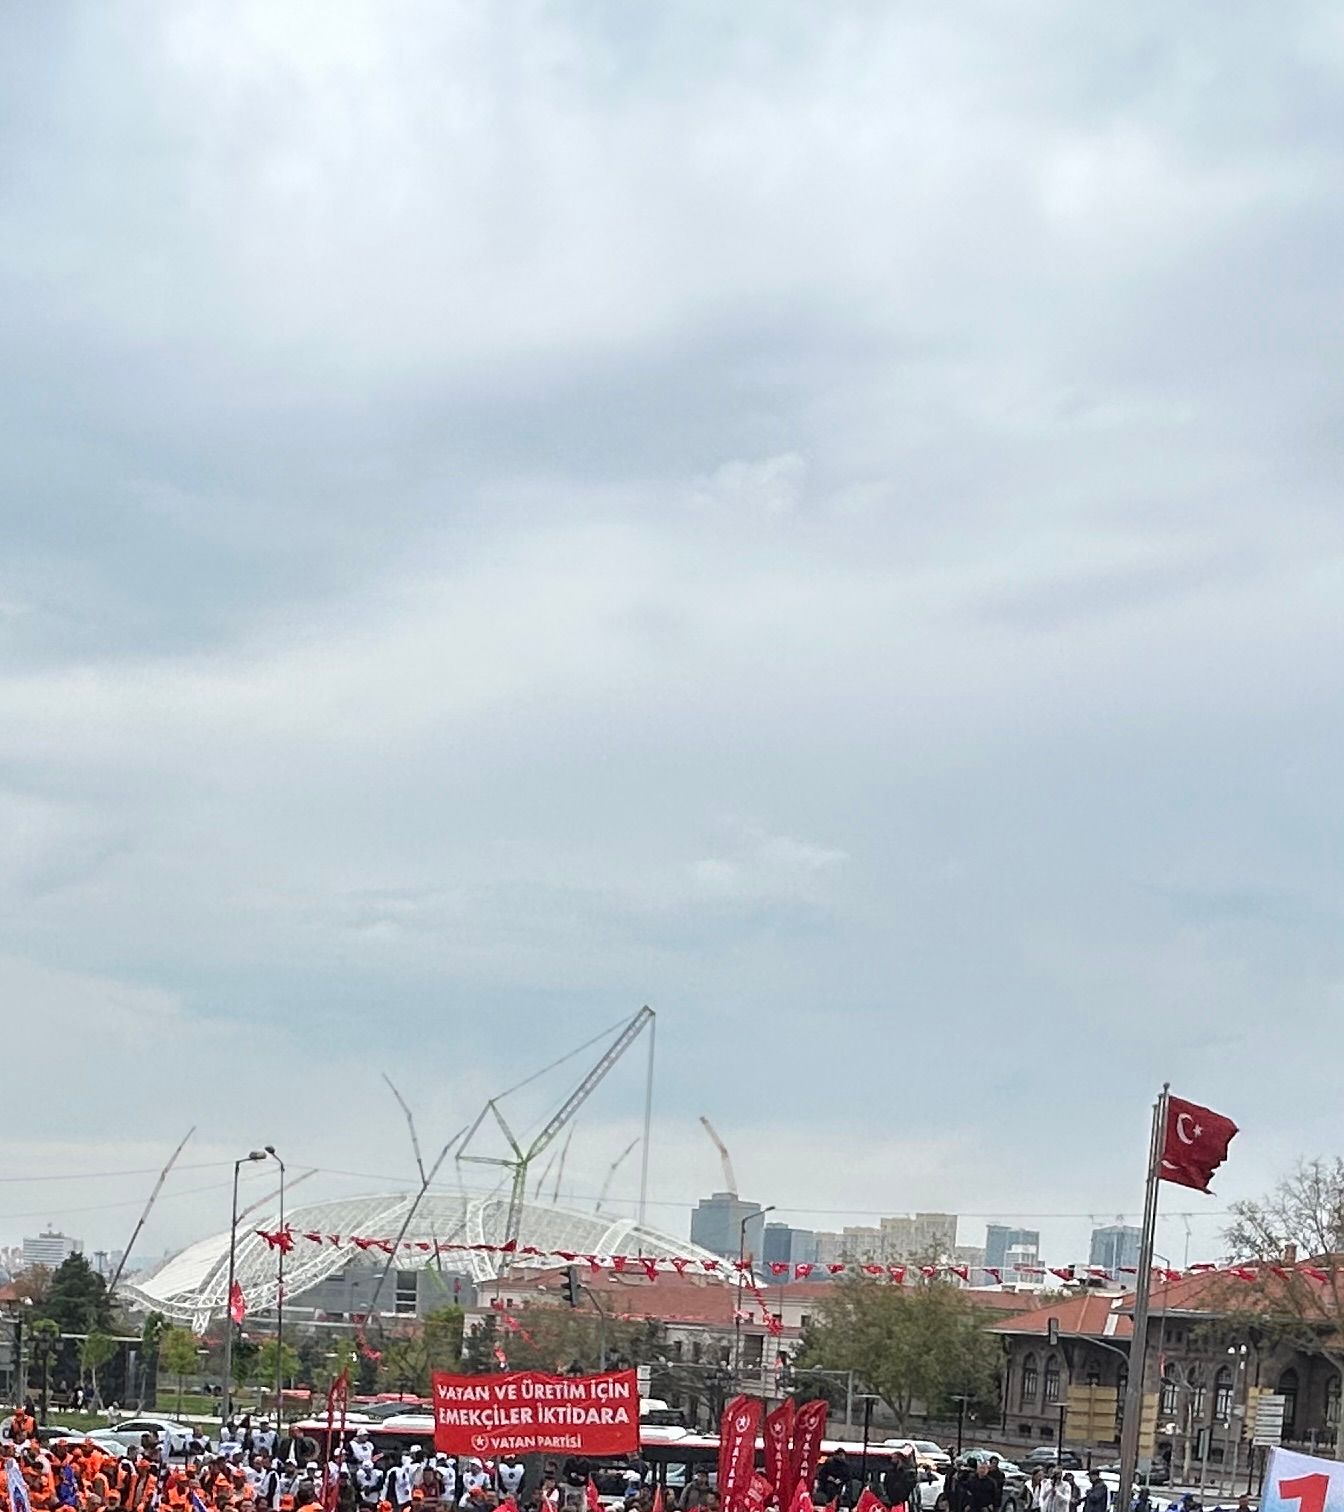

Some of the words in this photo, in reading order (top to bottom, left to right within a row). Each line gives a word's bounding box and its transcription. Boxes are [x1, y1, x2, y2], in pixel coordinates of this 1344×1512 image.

[439, 1384, 489, 1401] VATAN
[494, 1385, 517, 1401] VE
[521, 1378, 586, 1401] ÜRETİM
[590, 1377, 630, 1402] İÇİN
[439, 1404, 535, 1427] EMEKÇİLER
[537, 1402, 630, 1424] İKTİDARA
[490, 1437, 535, 1451] VATAN
[537, 1433, 582, 1449] PARTİSİ
